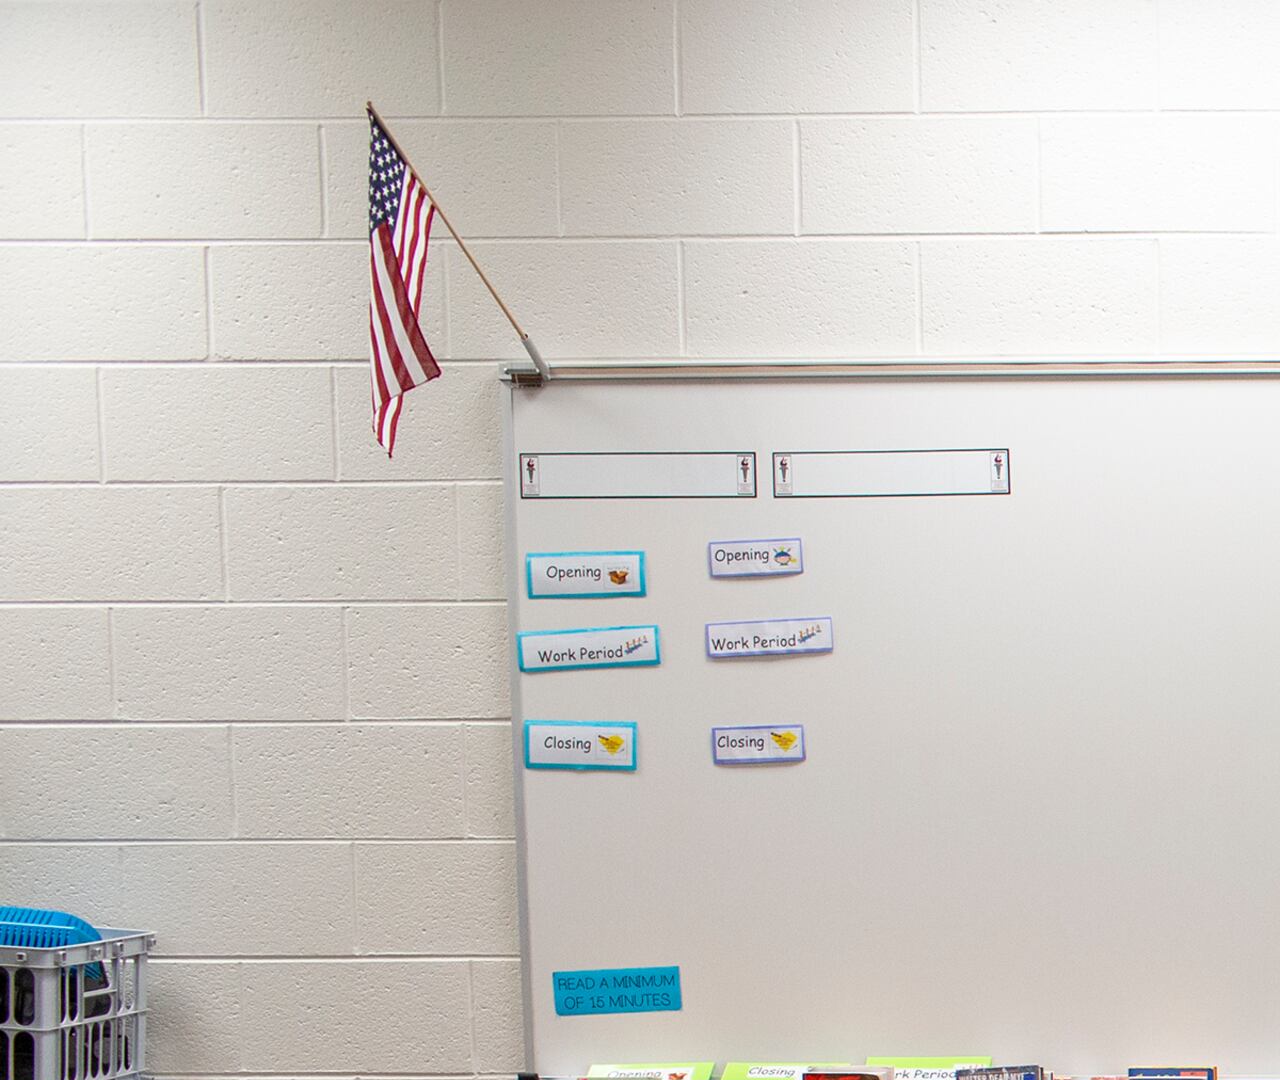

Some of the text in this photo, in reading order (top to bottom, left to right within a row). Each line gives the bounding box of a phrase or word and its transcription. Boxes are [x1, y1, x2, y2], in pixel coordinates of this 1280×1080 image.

[714, 547, 770, 564] Opening
[546, 563, 602, 583] Opening
[712, 633, 797, 652] Work Period
[538, 645, 624, 663] Work Period
[544, 736, 592, 753] Closing
[717, 735, 765, 753] Closing
[558, 973, 675, 991] READ A MINIMUM
[564, 992, 671, 1010] OF 15 MINUTES
[748, 1066, 796, 1078] Closing
[895, 1069, 910, 1079] rk
